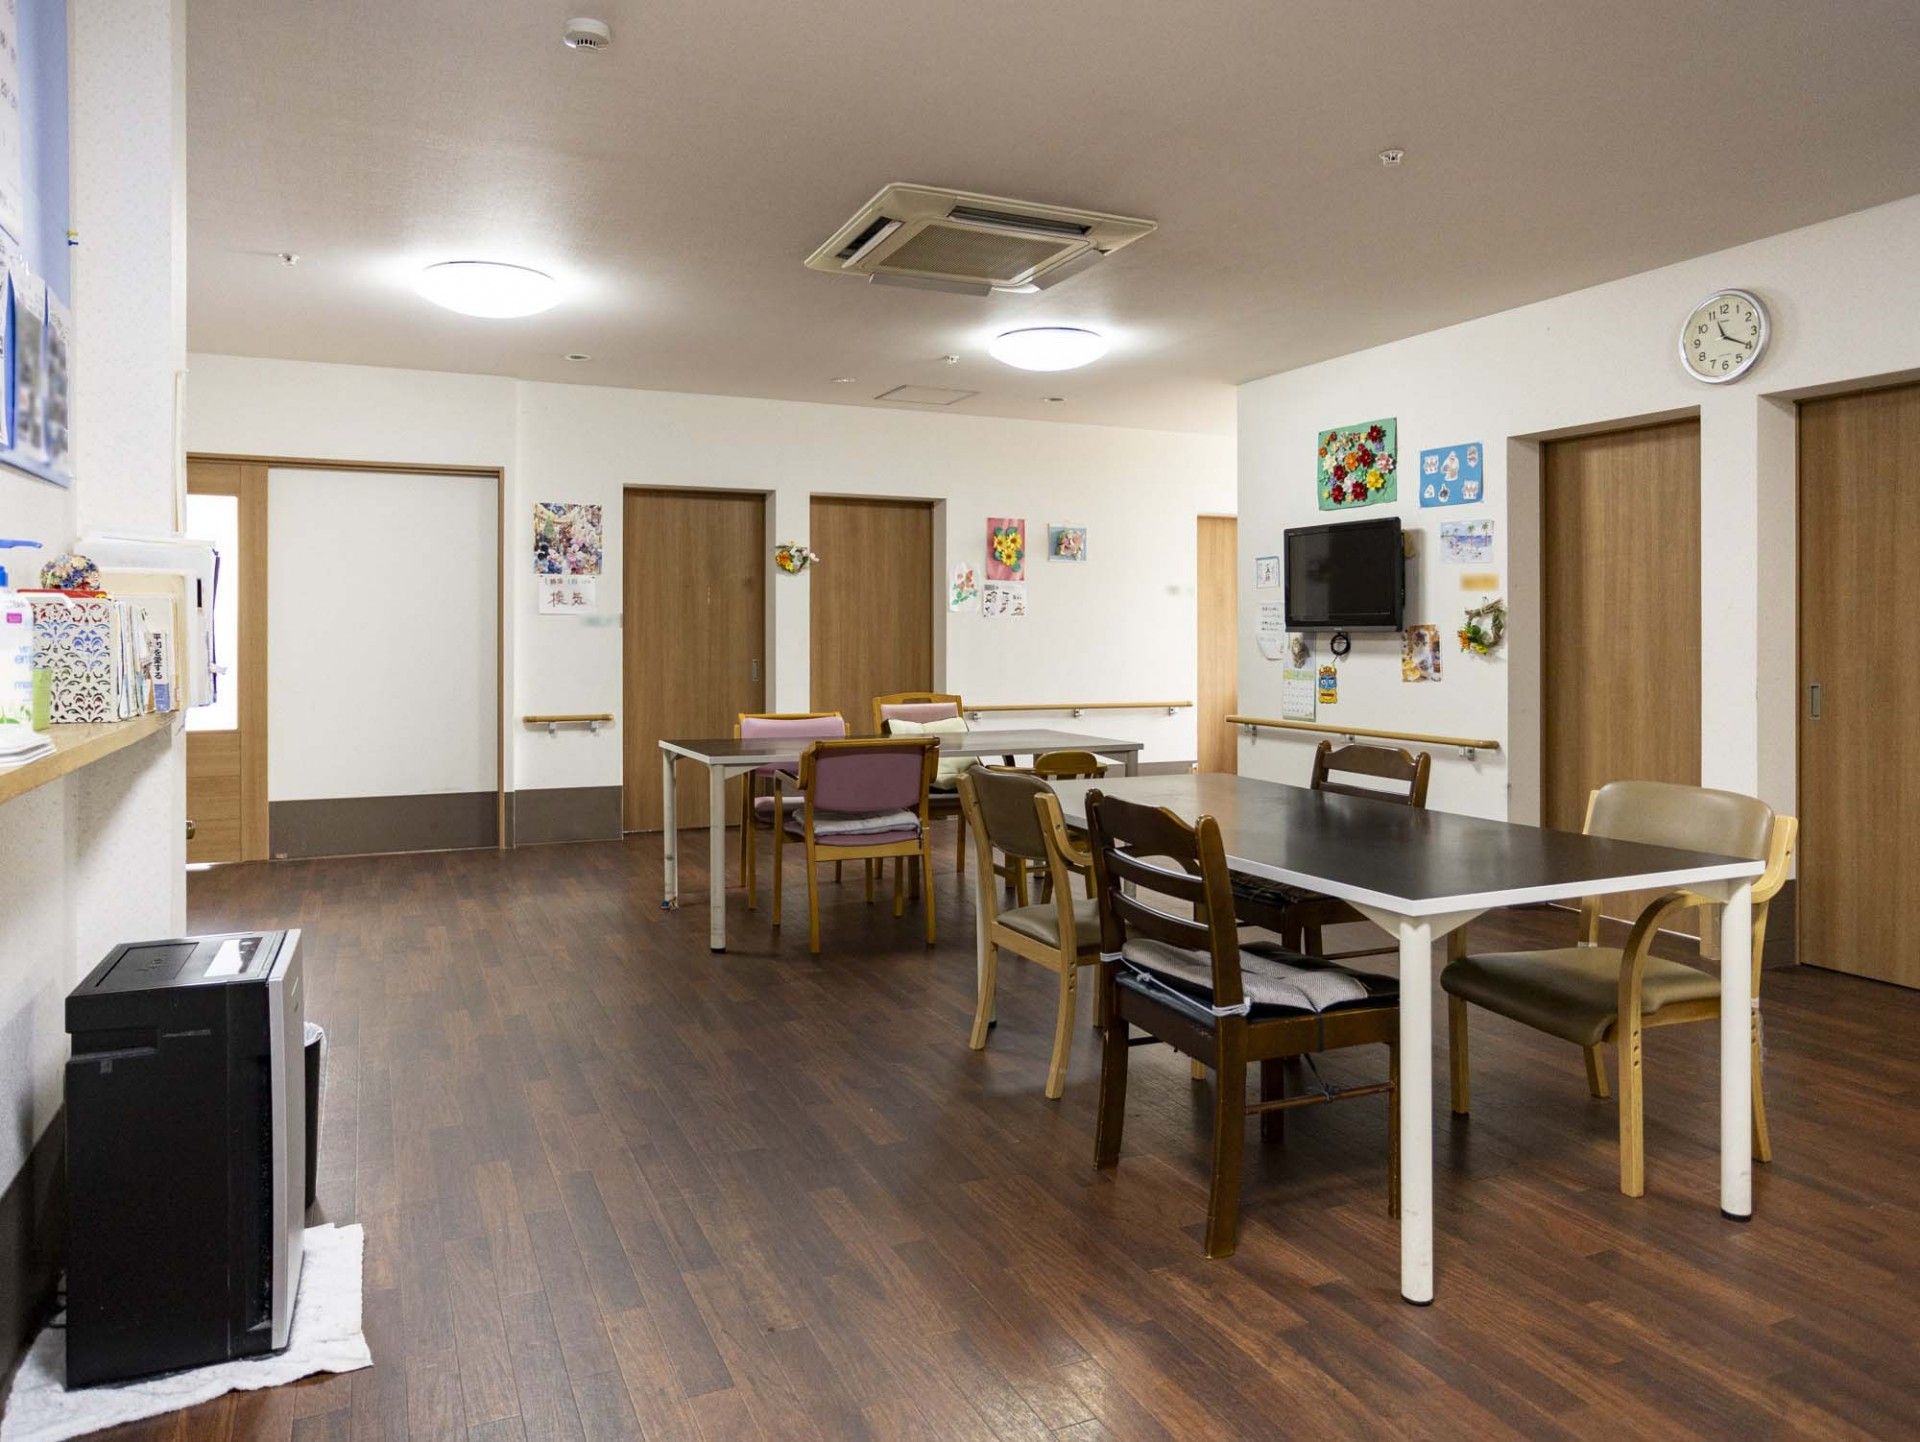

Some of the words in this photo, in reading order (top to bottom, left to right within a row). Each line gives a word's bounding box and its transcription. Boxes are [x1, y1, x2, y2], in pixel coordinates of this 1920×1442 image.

[1719, 303, 1729, 314] 12
[1709, 311, 1716, 321] 11
[1745, 311, 1752, 322] 2
[1698, 324, 1708, 334] 10
[1750, 325, 1757, 335] 3
[1693, 339, 1701, 349] 9
[1745, 340, 1753, 350] 4
[1699, 352, 1706, 362] 8
[1736, 354, 1743, 364] 5
[1710, 360, 1716, 369] 7
[1722, 361, 1729, 370] 6
